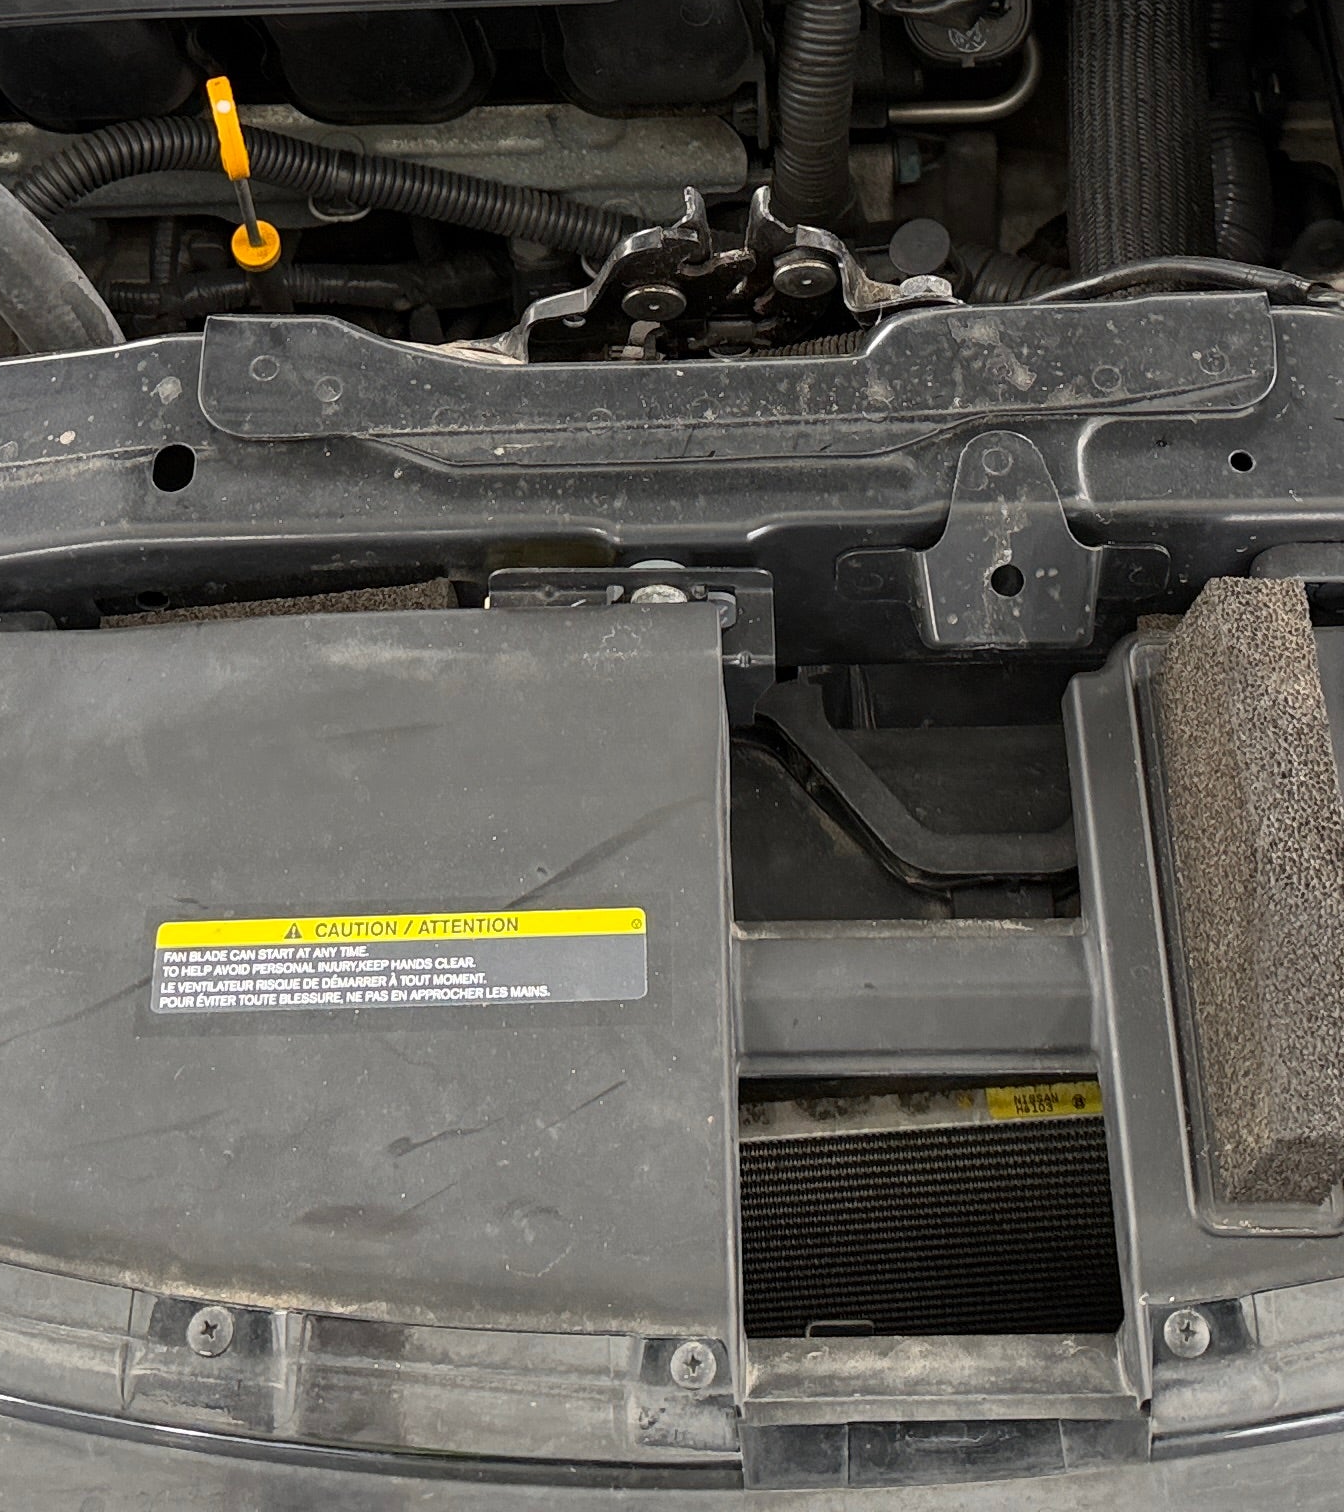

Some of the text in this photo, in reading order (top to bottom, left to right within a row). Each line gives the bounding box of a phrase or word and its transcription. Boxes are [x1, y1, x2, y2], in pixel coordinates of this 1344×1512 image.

[315, 917, 519, 938] CAUTION / ATTENTION
[163, 945, 369, 963] FAN BLADE CAN START AT ANY TIME.
[163, 965, 179, 977] TO
[181, 964, 212, 977] HELP
[213, 963, 251, 976] AVOID
[252, 962, 315, 975] PERSONAL
[391, 958, 433, 971] HANDS
[434, 957, 476, 970] CLEAR.
[161, 972, 487, 994] LE VENTILATEUR RISQUE DE DÉMARRER À TOUT MOMENT.
[159, 985, 550, 1008] POUR ÉVITER TOUTE BLESSURE, NE PAS EN APPROCHER LES MAINS.
[1014, 1092, 1058, 1105] NISSAN
